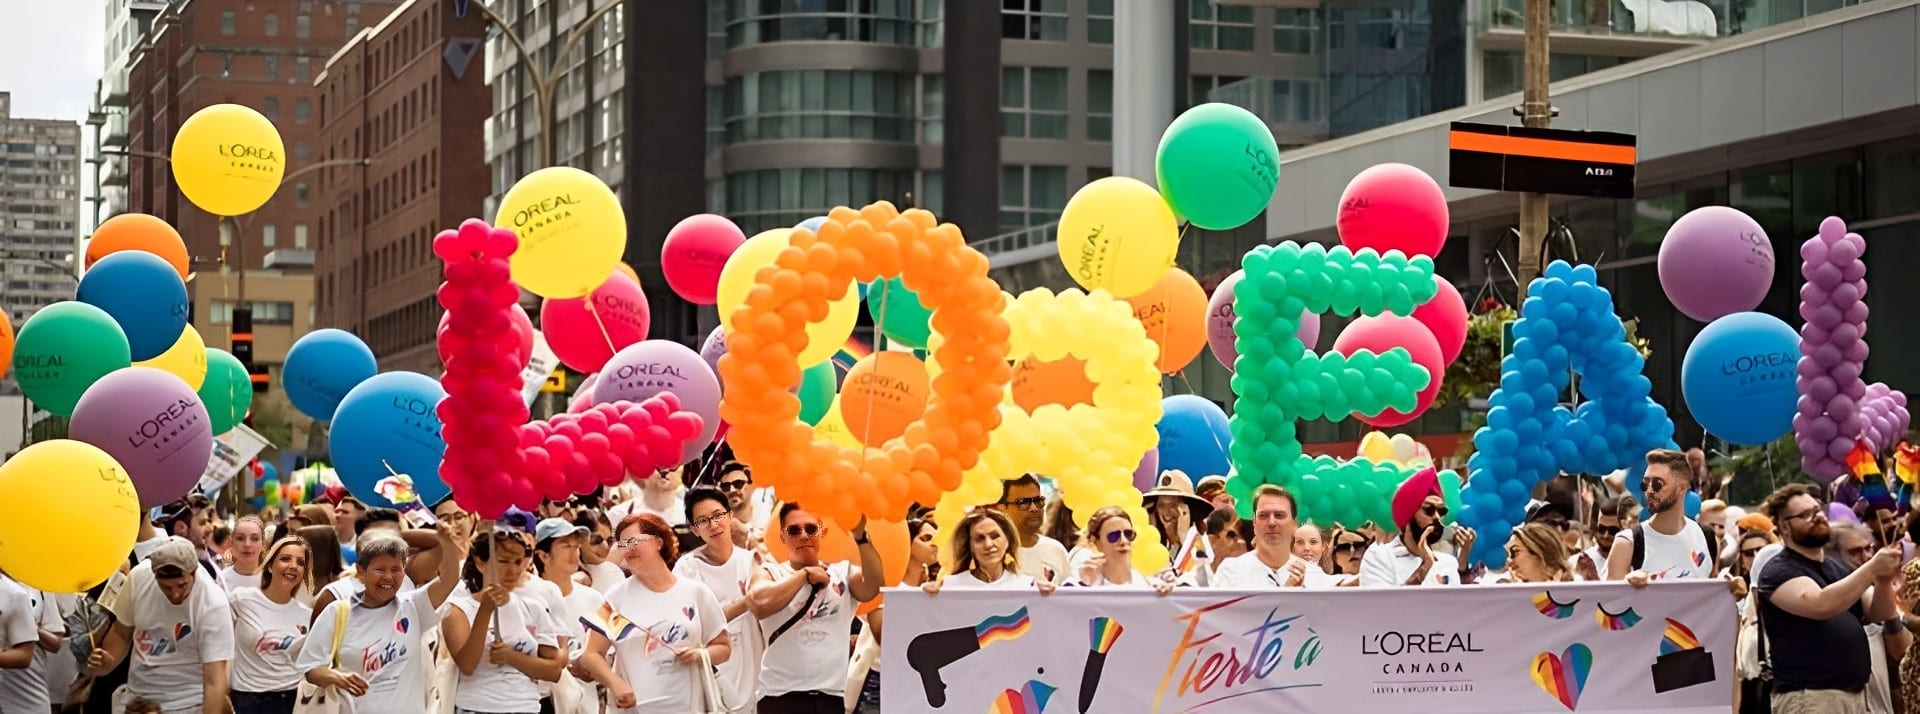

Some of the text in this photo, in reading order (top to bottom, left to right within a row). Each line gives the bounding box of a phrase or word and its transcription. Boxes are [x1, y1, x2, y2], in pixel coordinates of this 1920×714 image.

[1153, 594, 1323, 714] Fierté à
[1383, 661, 1463, 675] CANADA
